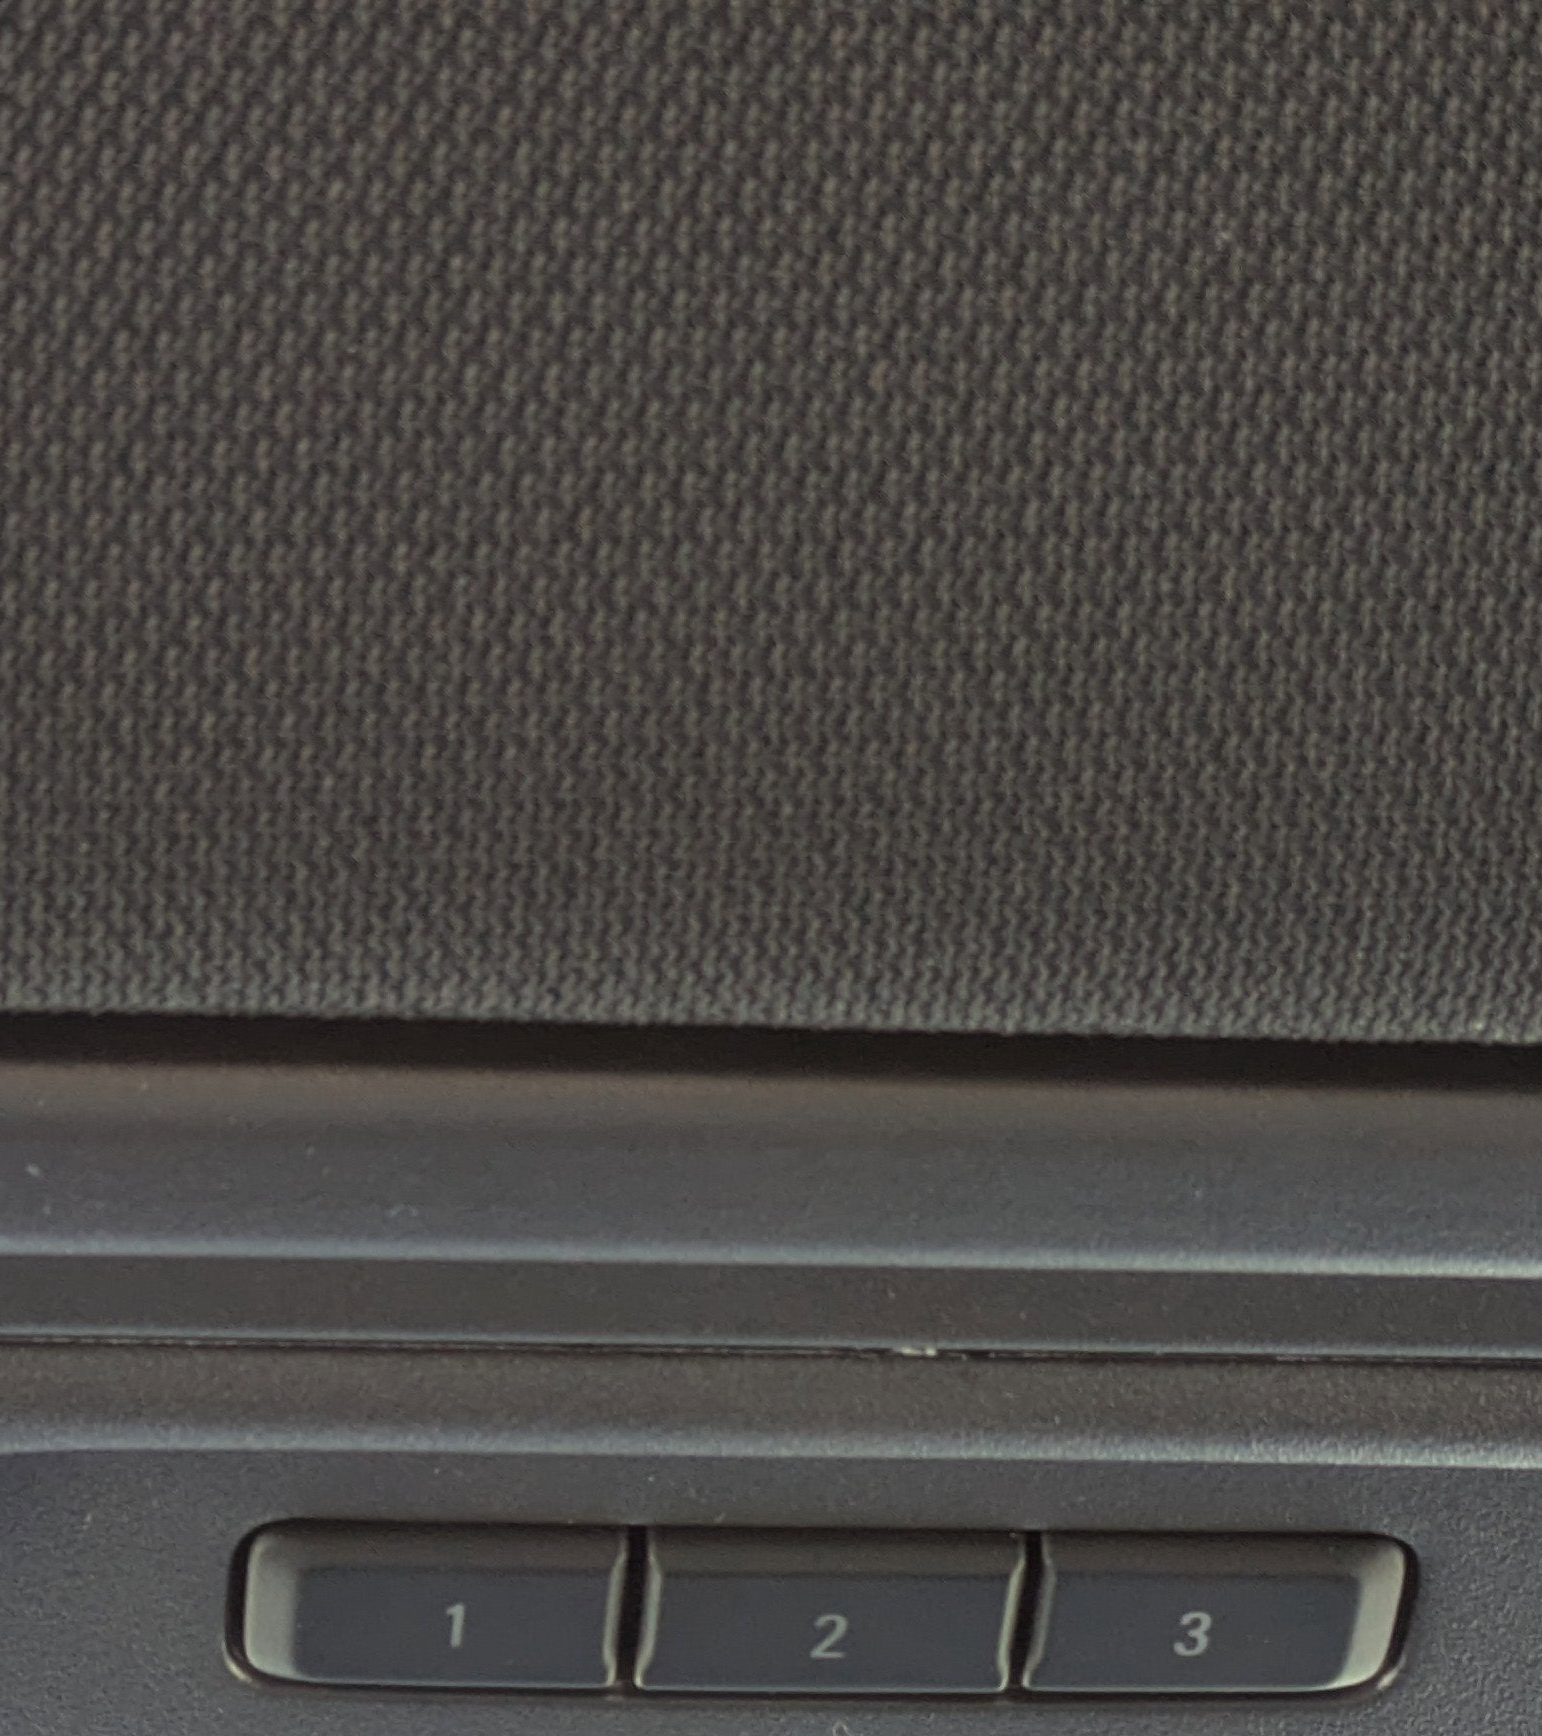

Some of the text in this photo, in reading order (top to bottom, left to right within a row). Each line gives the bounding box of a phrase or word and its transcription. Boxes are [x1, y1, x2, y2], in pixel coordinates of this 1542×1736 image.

[445, 1603, 465, 1648] 1
[810, 1615, 848, 1659] 2
[1173, 1611, 1212, 1656] 3
